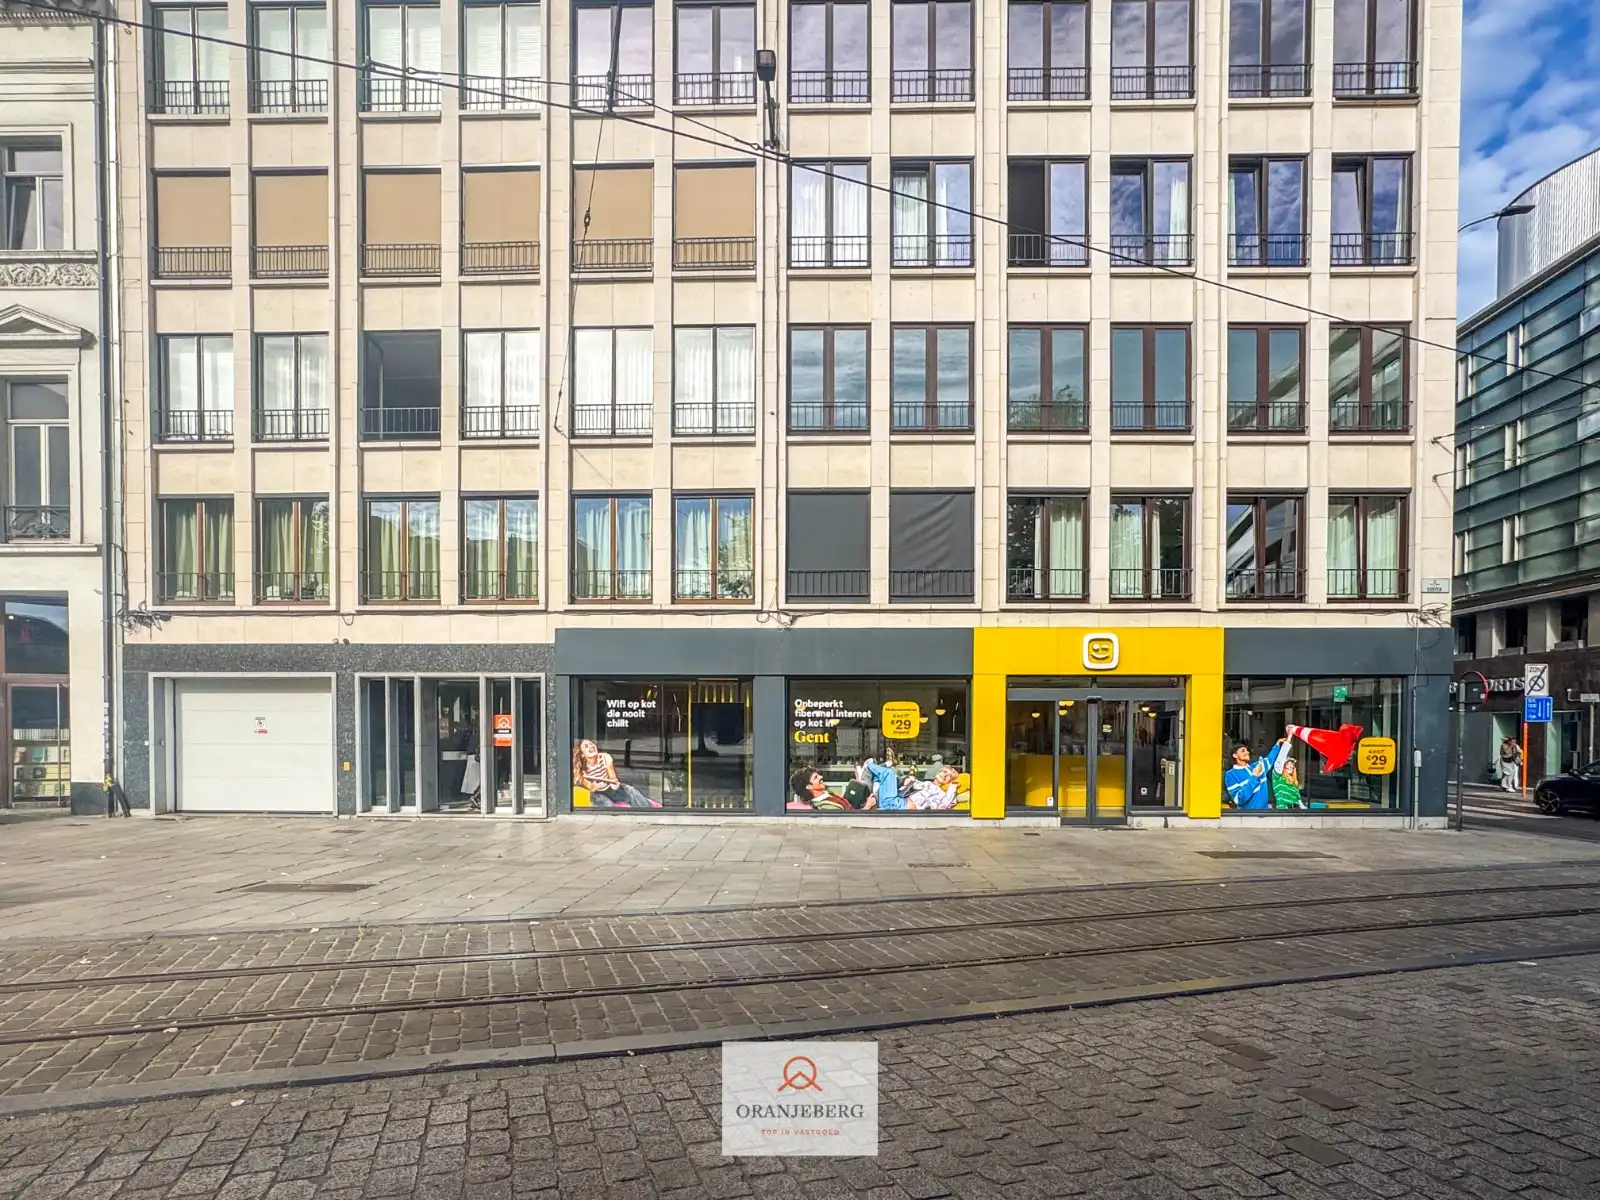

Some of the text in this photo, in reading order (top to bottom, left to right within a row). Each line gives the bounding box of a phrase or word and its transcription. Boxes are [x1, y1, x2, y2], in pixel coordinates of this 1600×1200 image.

[606, 700, 656, 710] Wifi op kot
[794, 699, 844, 709] Onbeperkt
[606, 710, 646, 718] die nooit
[794, 709, 872, 718] fibersnel internet
[606, 719, 629, 728] chillt
[794, 718, 835, 729] op kot in
[794, 730, 830, 744] Gent
